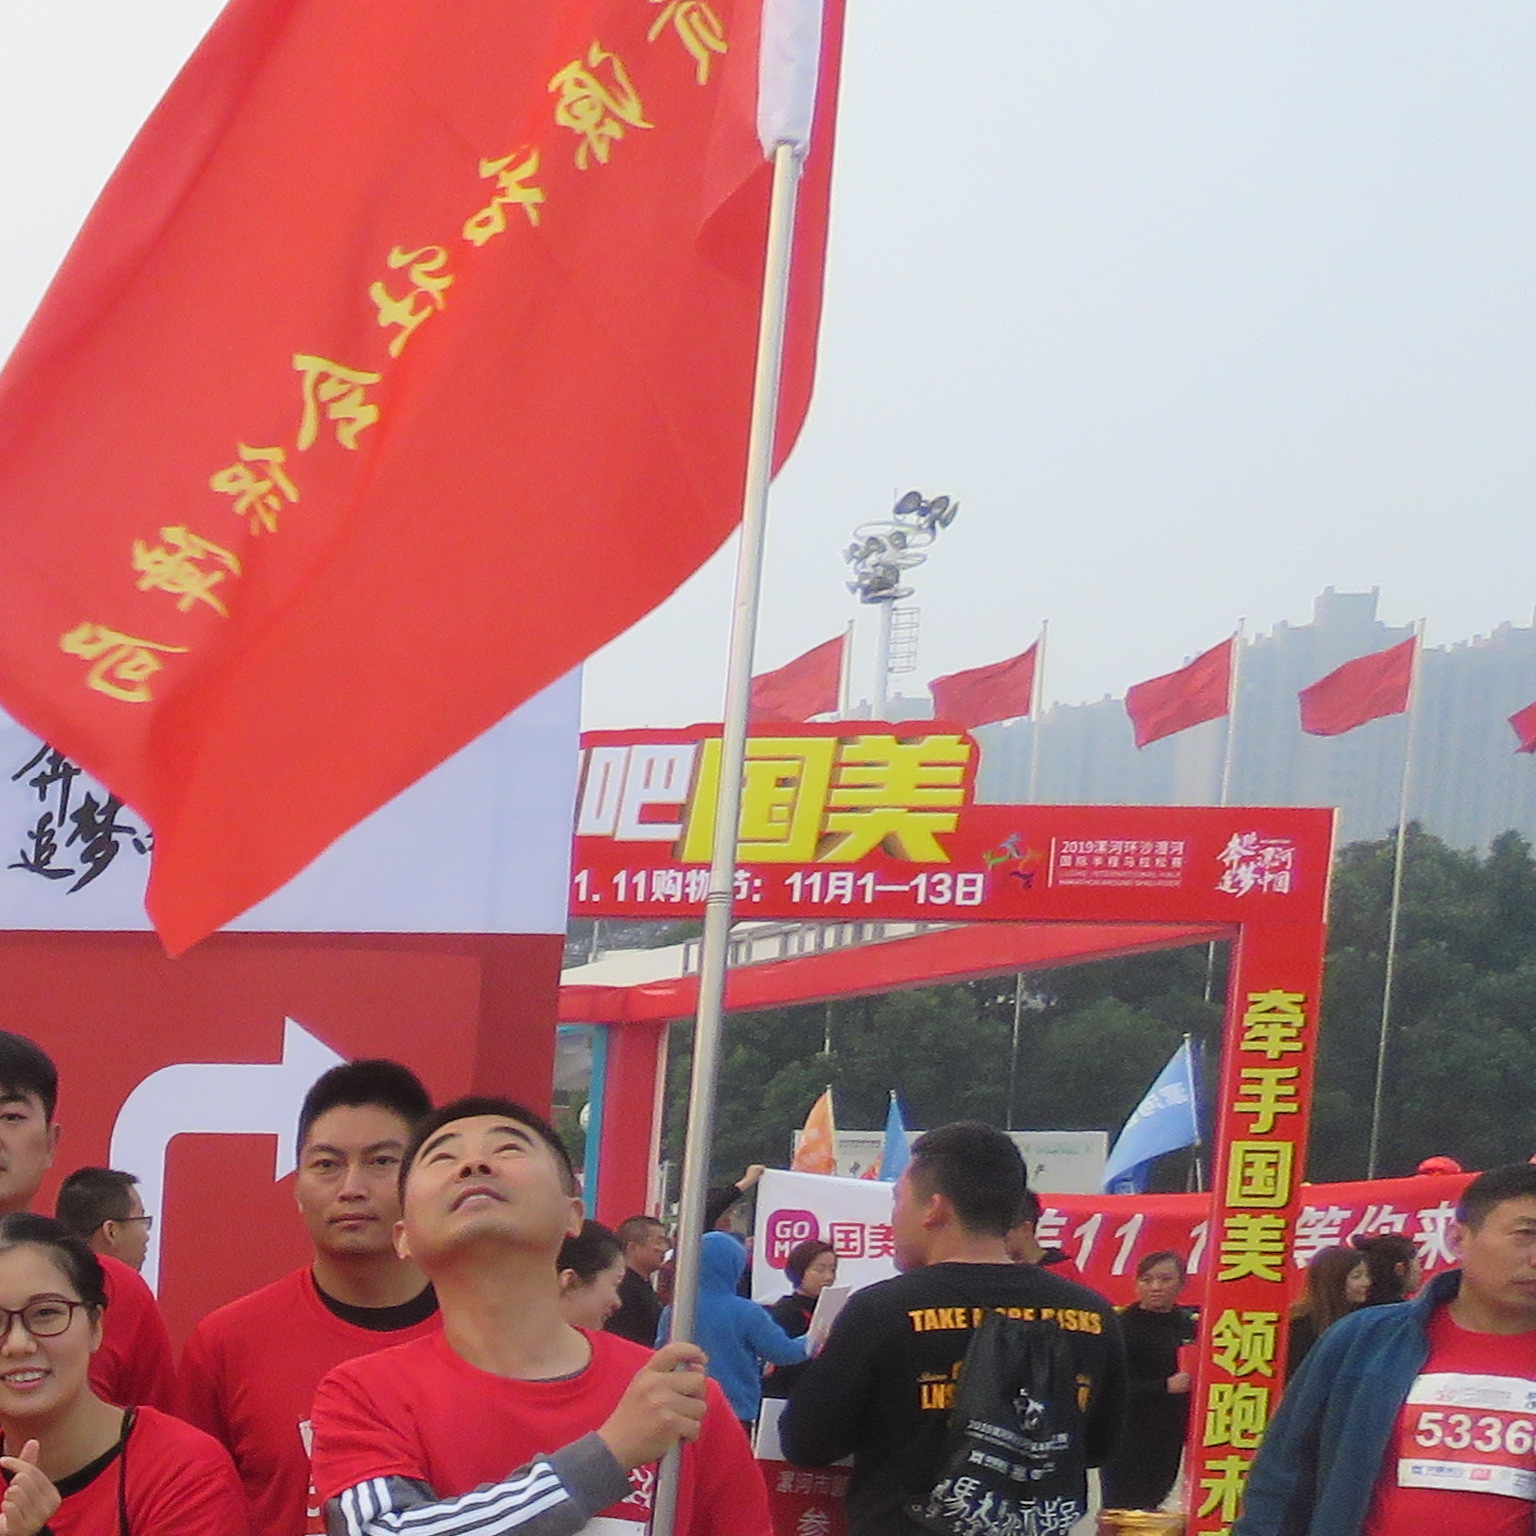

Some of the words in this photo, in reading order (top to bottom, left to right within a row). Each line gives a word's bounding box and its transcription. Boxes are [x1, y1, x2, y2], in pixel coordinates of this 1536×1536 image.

[1216, 988, 1308, 1284] 牵手国美
[773, 1220, 812, 1240] GO
[908, 1308, 968, 1333] TAKE
